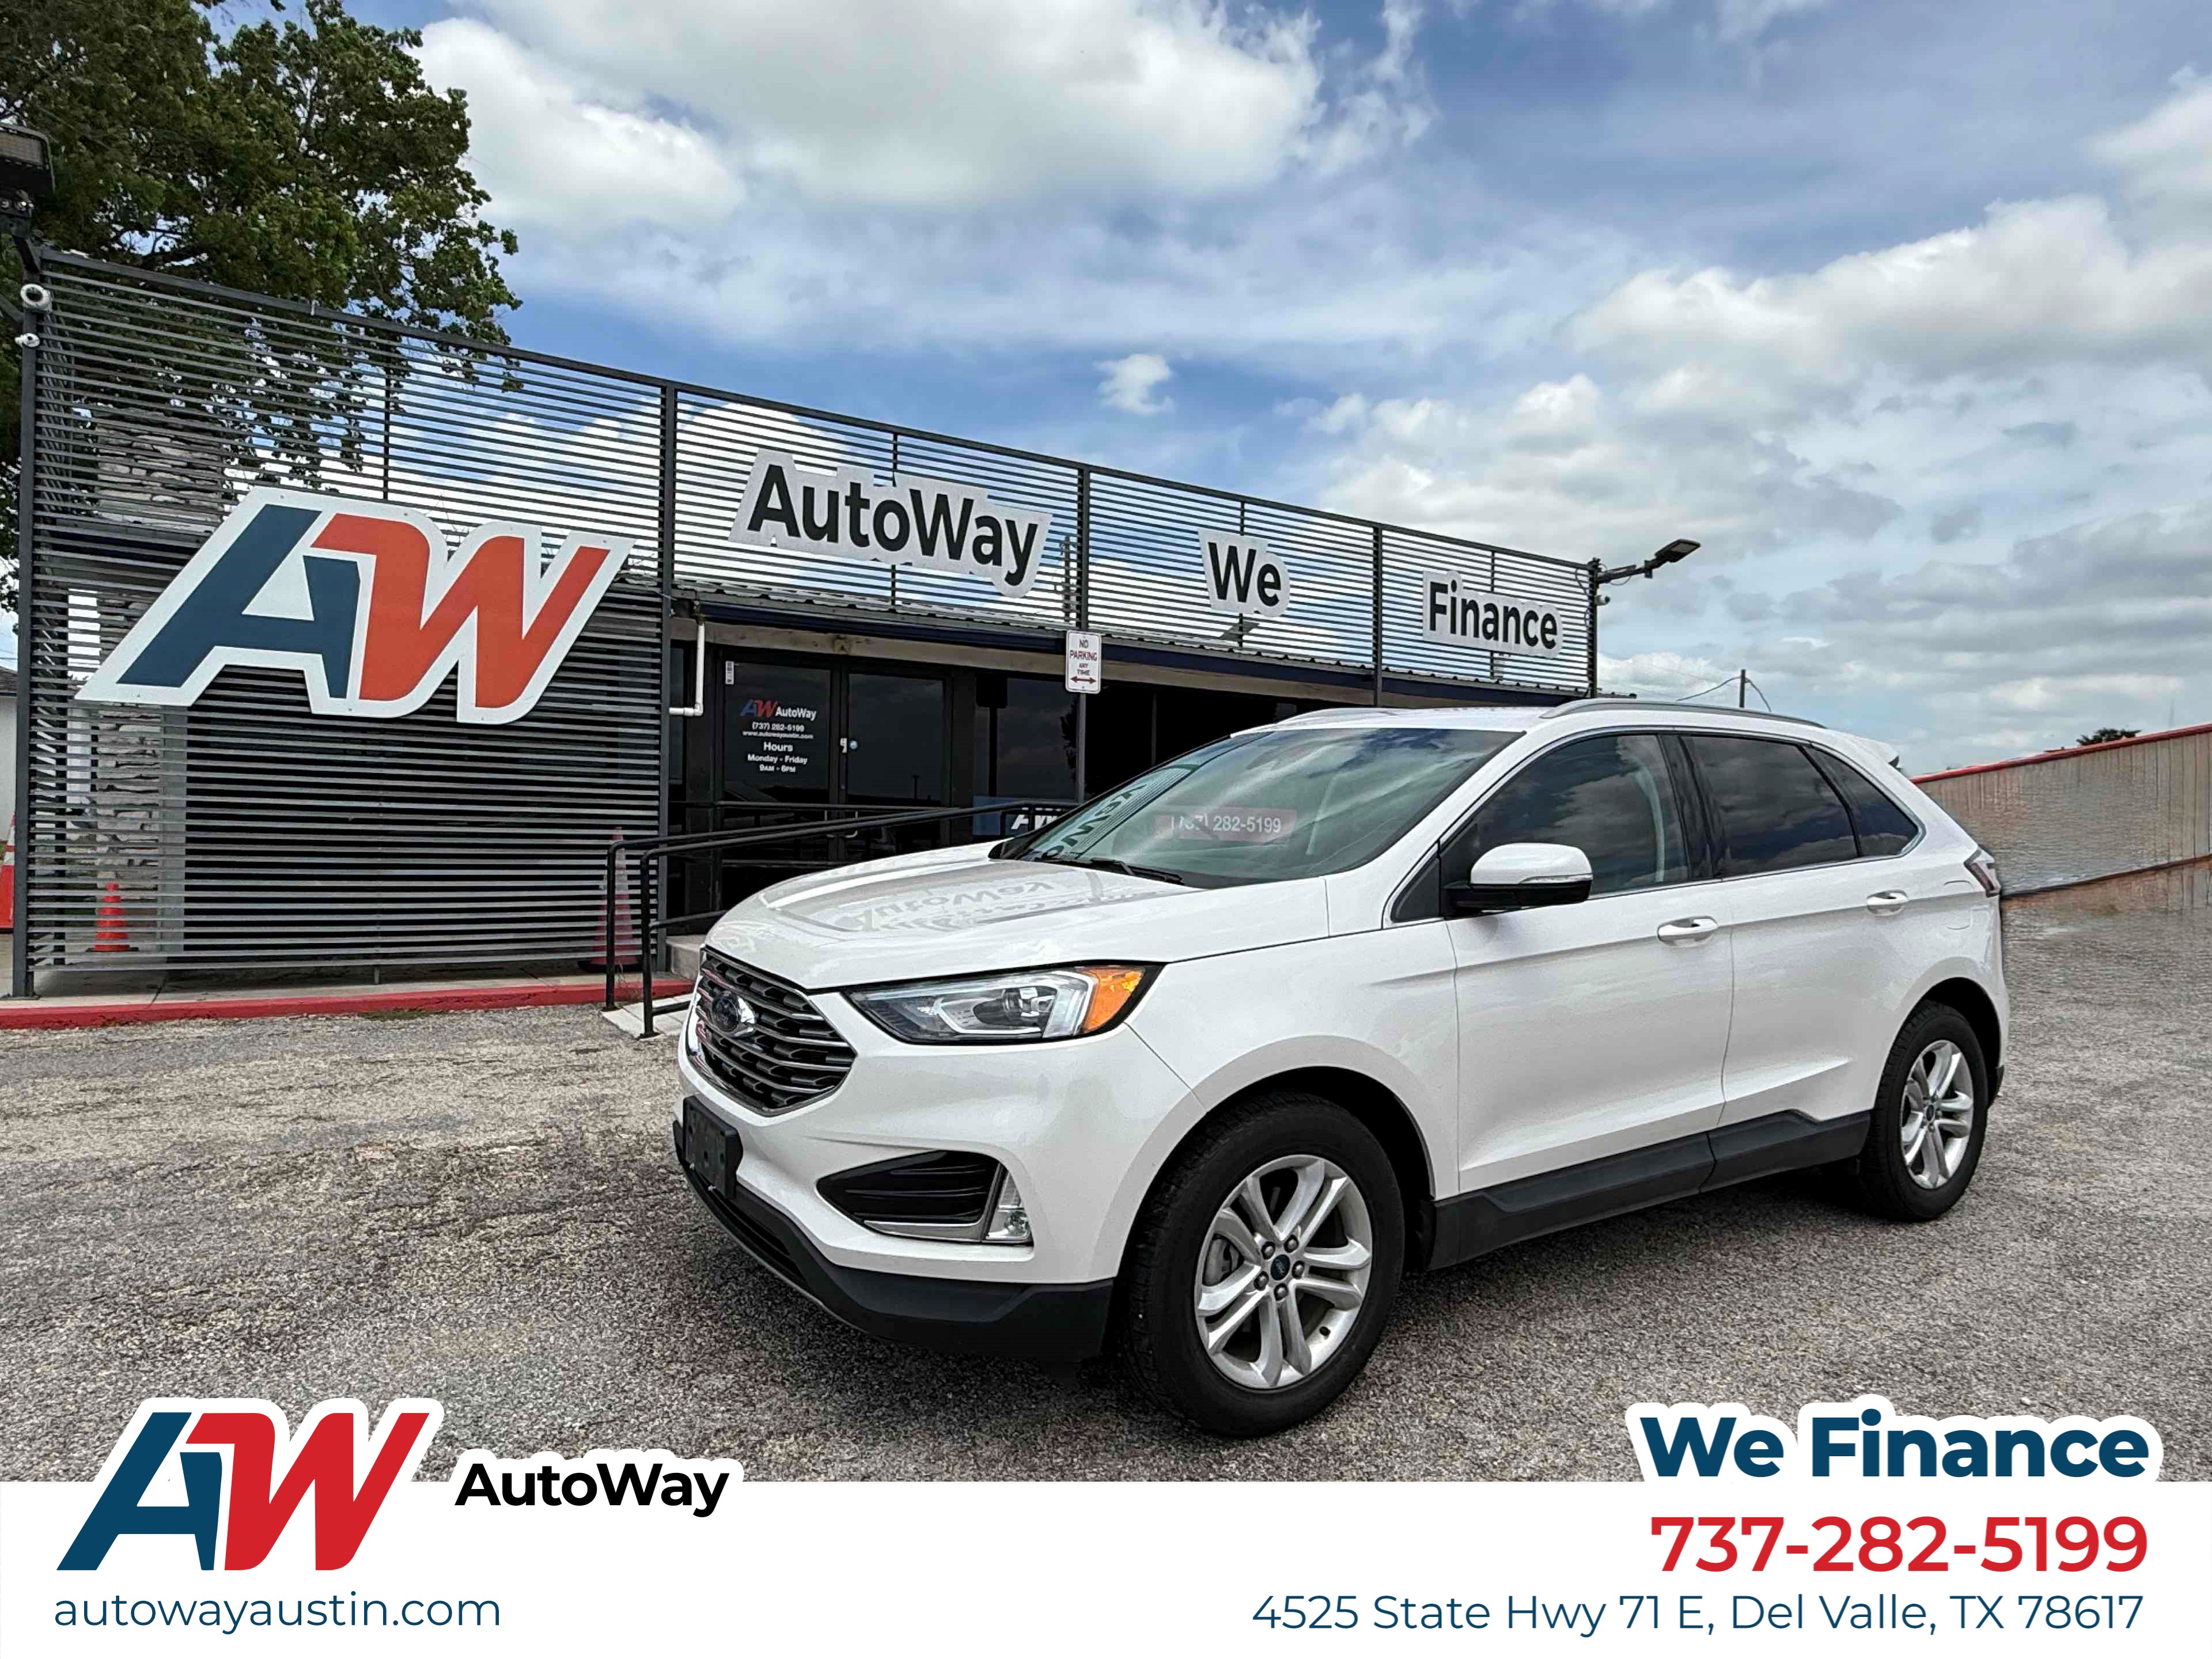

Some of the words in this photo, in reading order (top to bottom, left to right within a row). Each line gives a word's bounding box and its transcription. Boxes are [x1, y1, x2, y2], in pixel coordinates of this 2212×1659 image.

[747, 464, 1039, 586] AutoWay
[1207, 541, 1282, 607] We
[1429, 579, 1558, 650] Finance
[116, 503, 609, 709] AW
[1079, 639, 1089, 649] NO
[1069, 650, 1097, 661] PARKING
[775, 706, 817, 721] AutoWay
[752, 721, 770, 730] (737)
[763, 742, 793, 752] Hours
[747, 753, 778, 763] Monday
[785, 755, 808, 765] Friday
[1213, 815, 1282, 833] 282-5199
